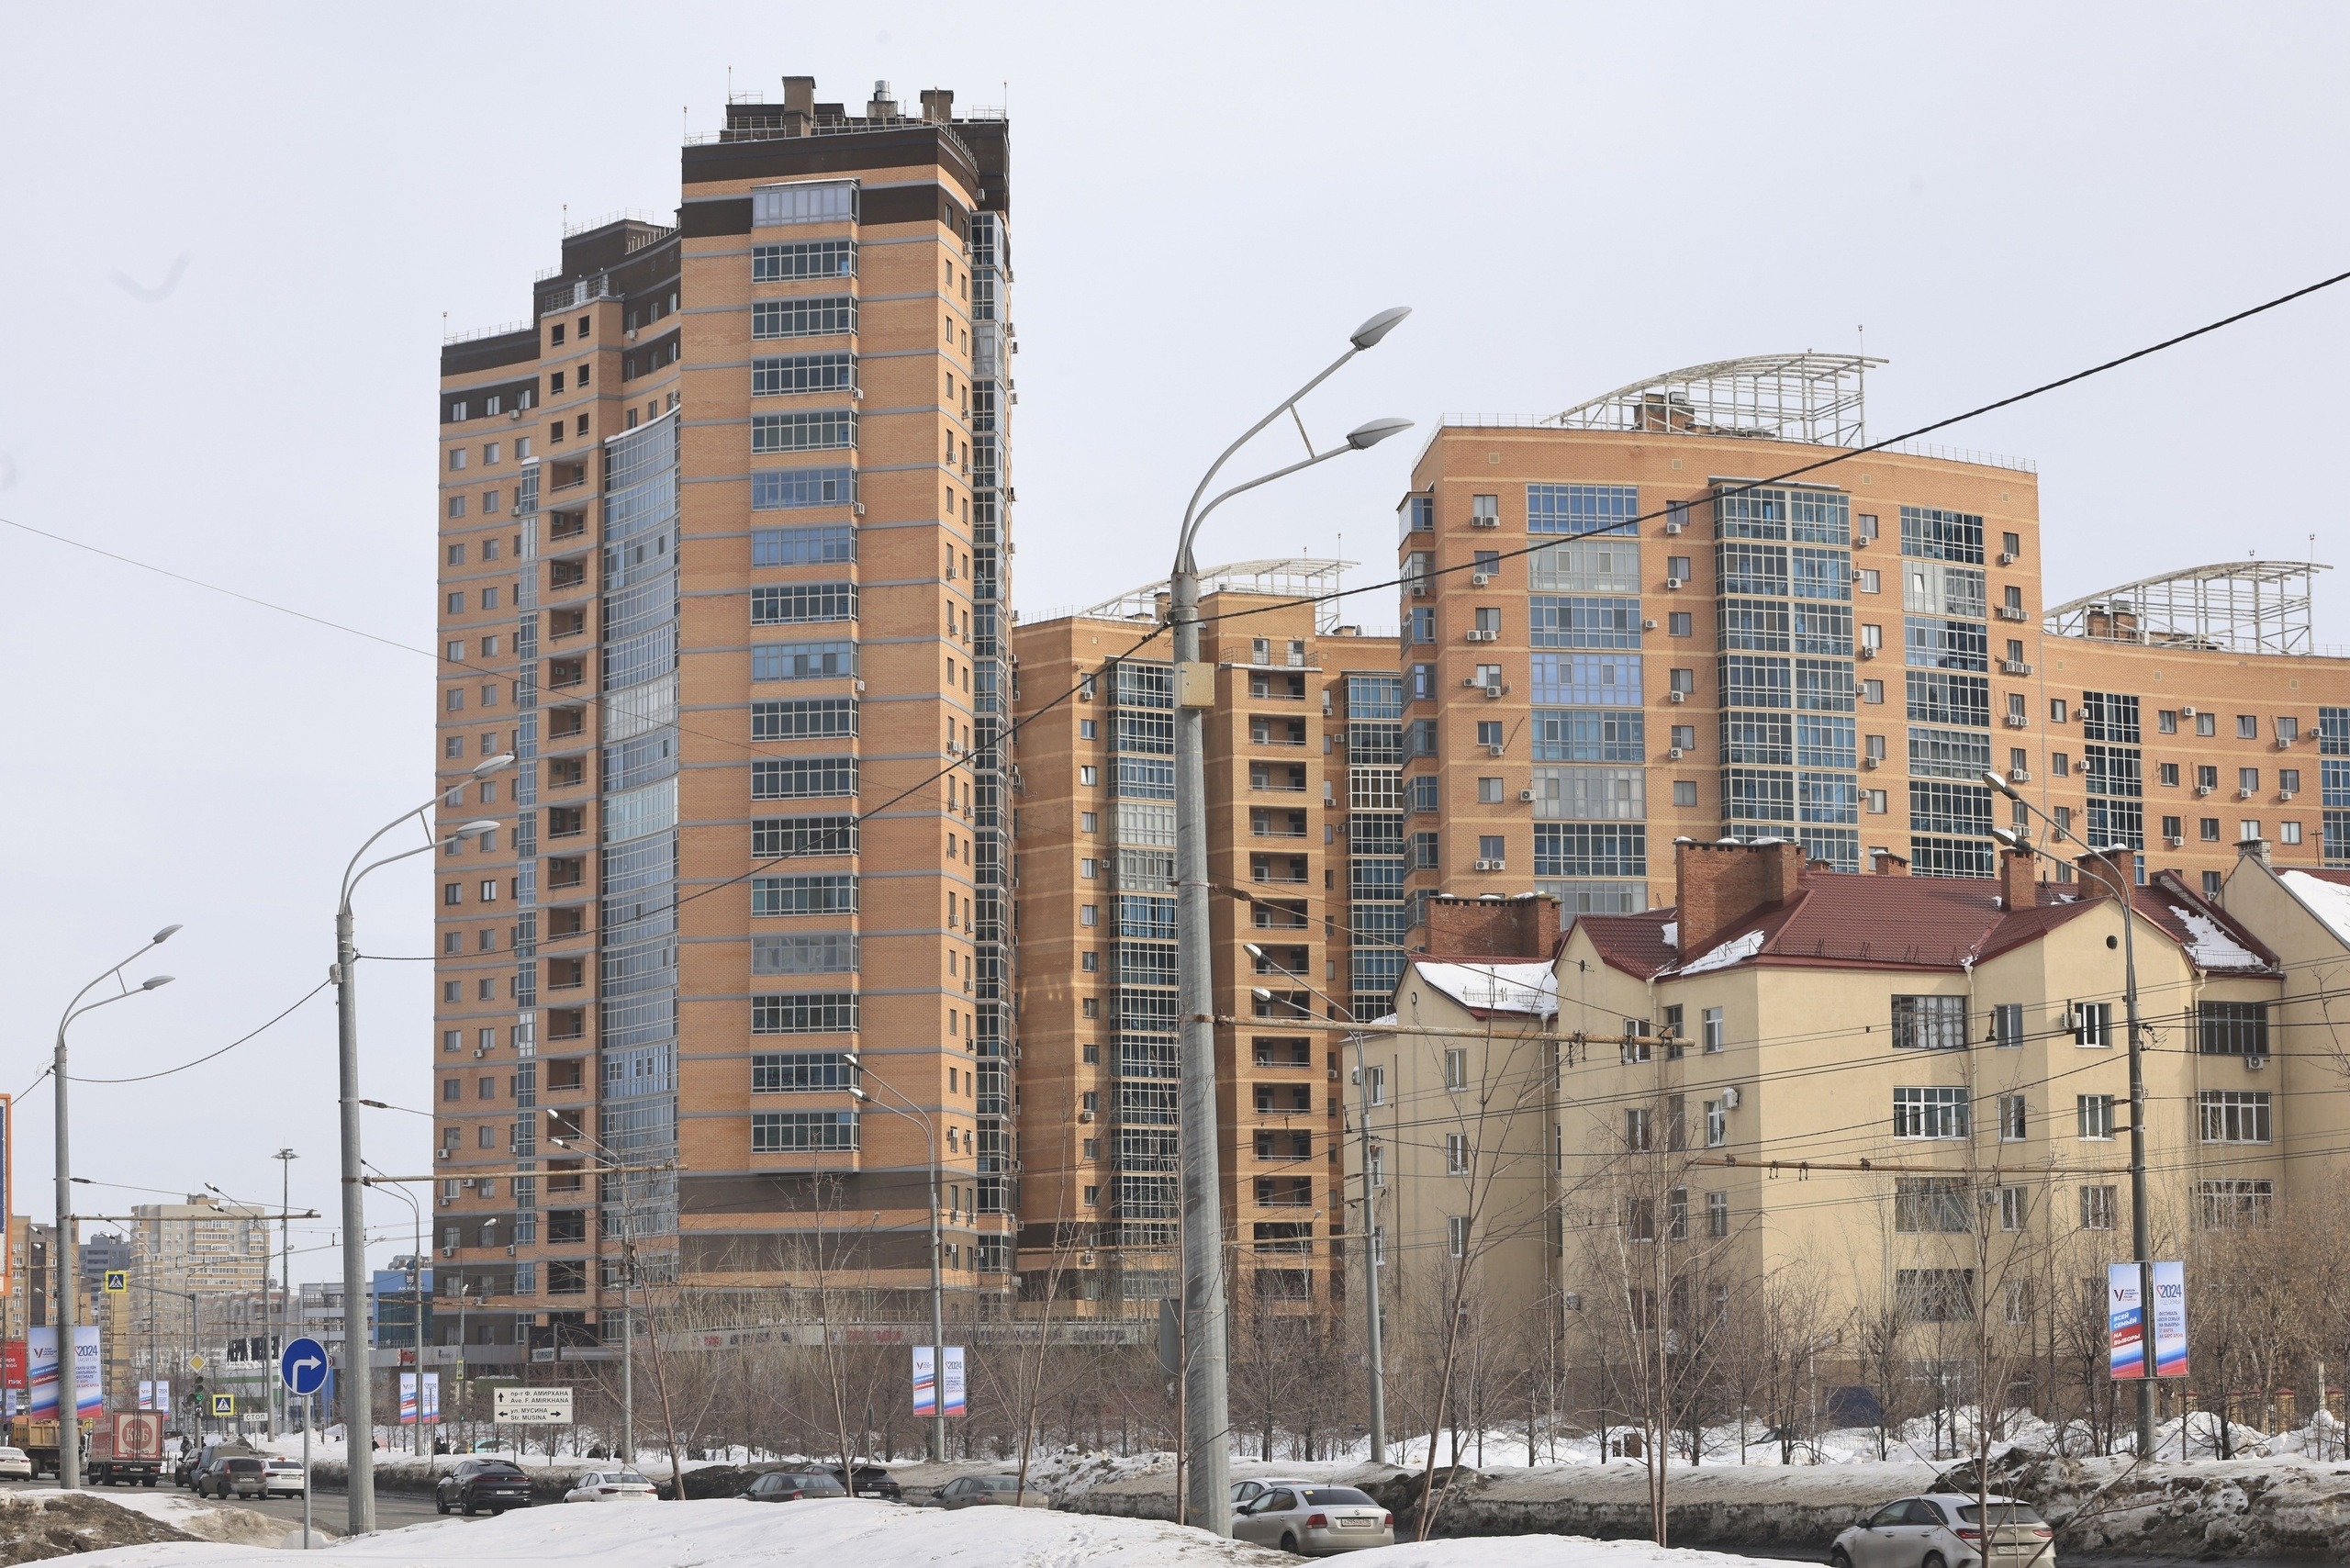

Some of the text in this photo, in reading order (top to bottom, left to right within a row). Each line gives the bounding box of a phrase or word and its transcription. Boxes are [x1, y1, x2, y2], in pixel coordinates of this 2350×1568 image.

[2160, 1284, 2182, 1298] 2024
[2113, 1312, 2130, 1322] ВСЕЙ
[2113, 1331, 2122, 1339] НА
[2113, 1333, 2141, 1346] ВЫБОРЫ
[77, 1345, 98, 1356] 2024
[948, 1361, 962, 1370] 2024
